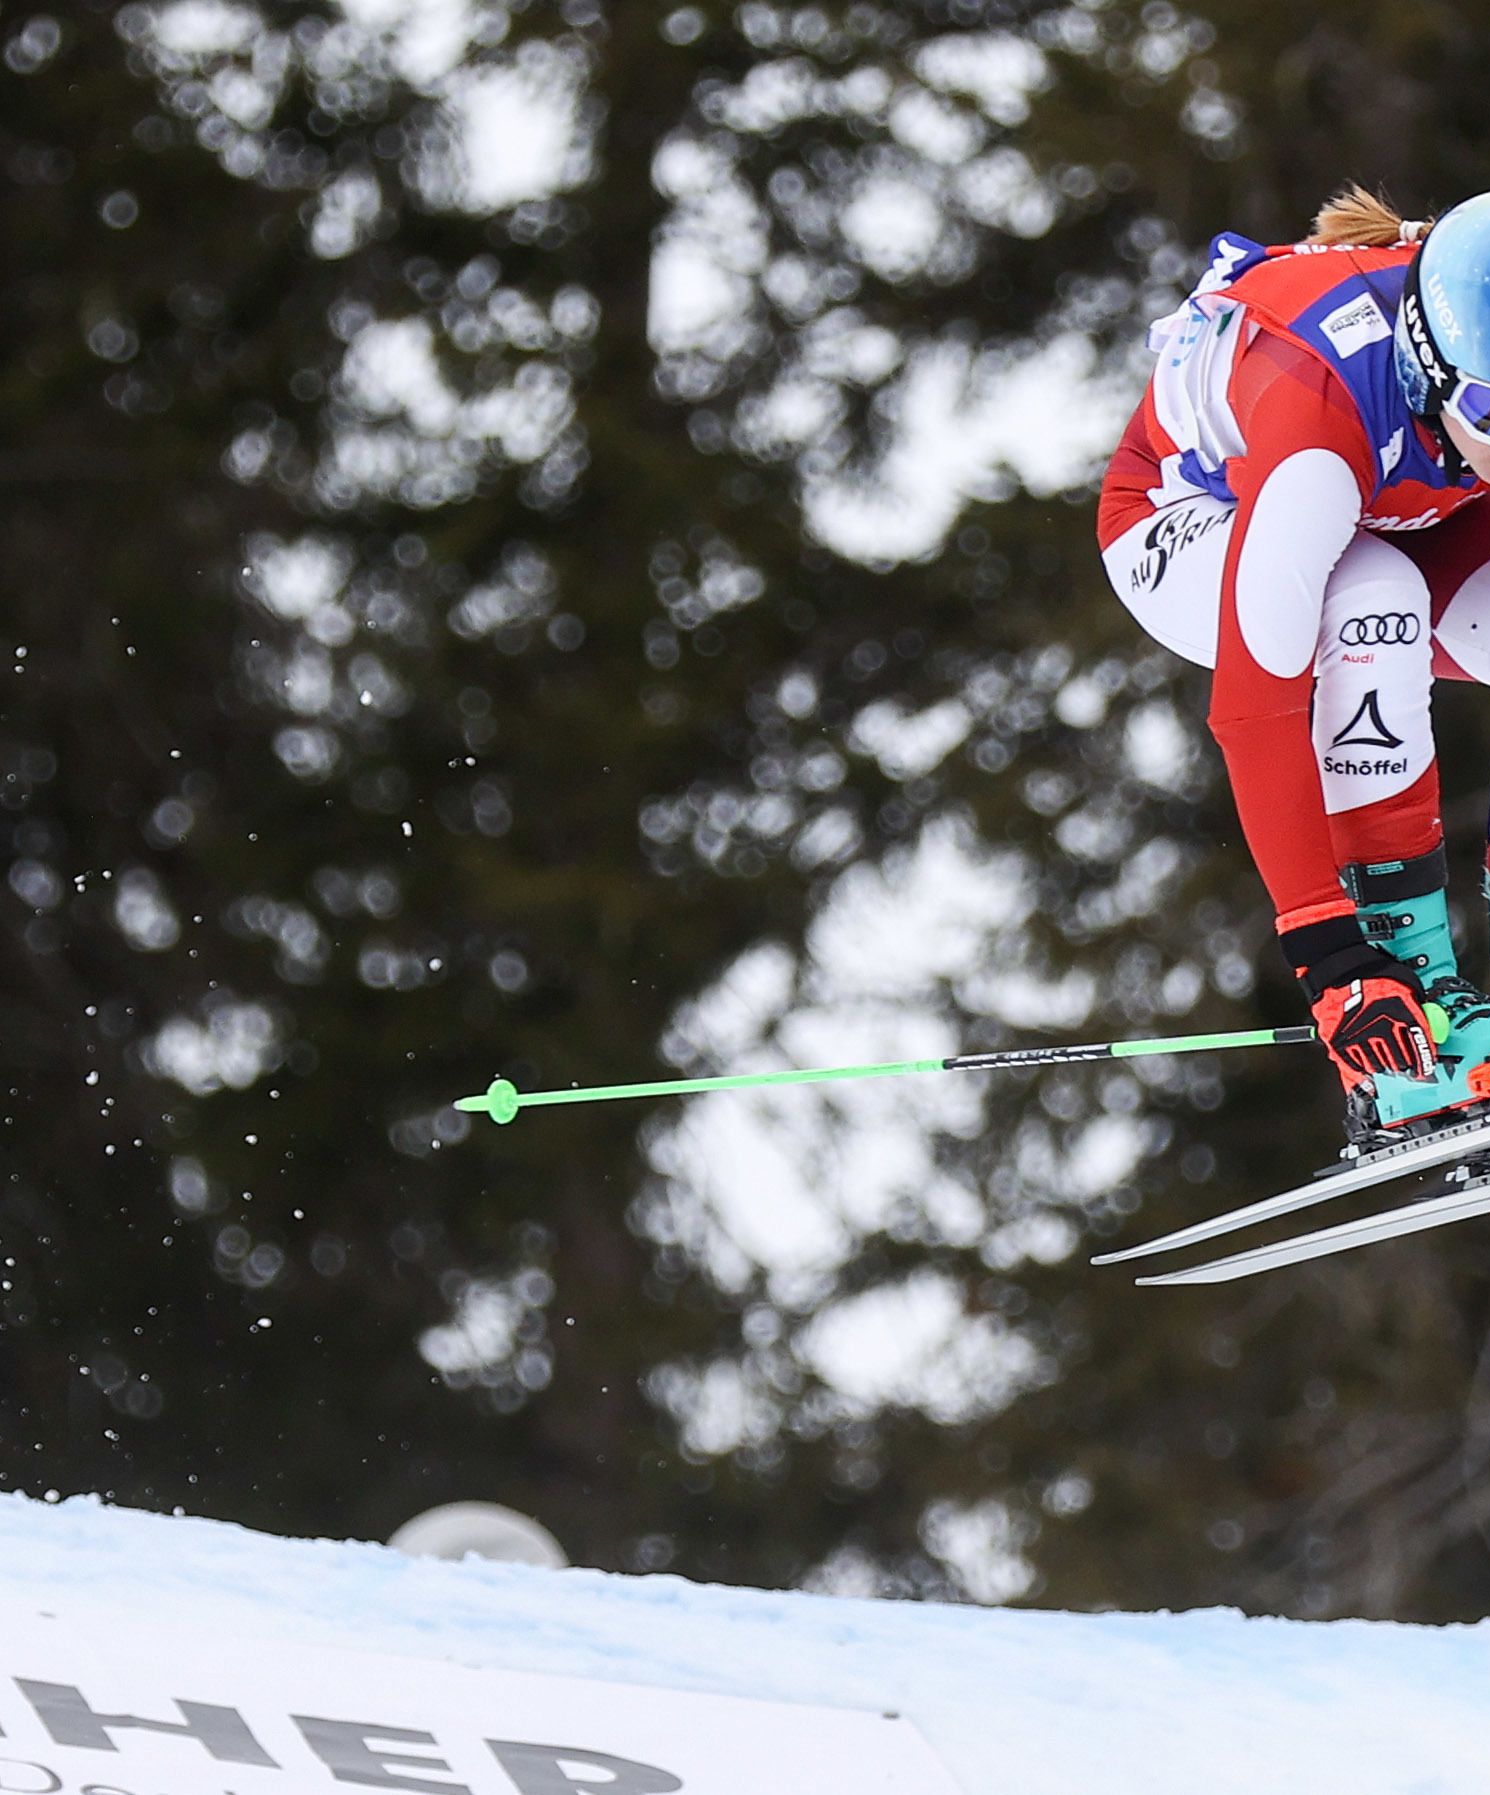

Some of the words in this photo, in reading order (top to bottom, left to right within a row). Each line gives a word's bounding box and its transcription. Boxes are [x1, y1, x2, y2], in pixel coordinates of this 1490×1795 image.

[1406, 294, 1449, 388] uvex
[1427, 273, 1463, 345] uvex
[1341, 653, 1375, 664] Audi
[0, 1676, 684, 1795] HER
